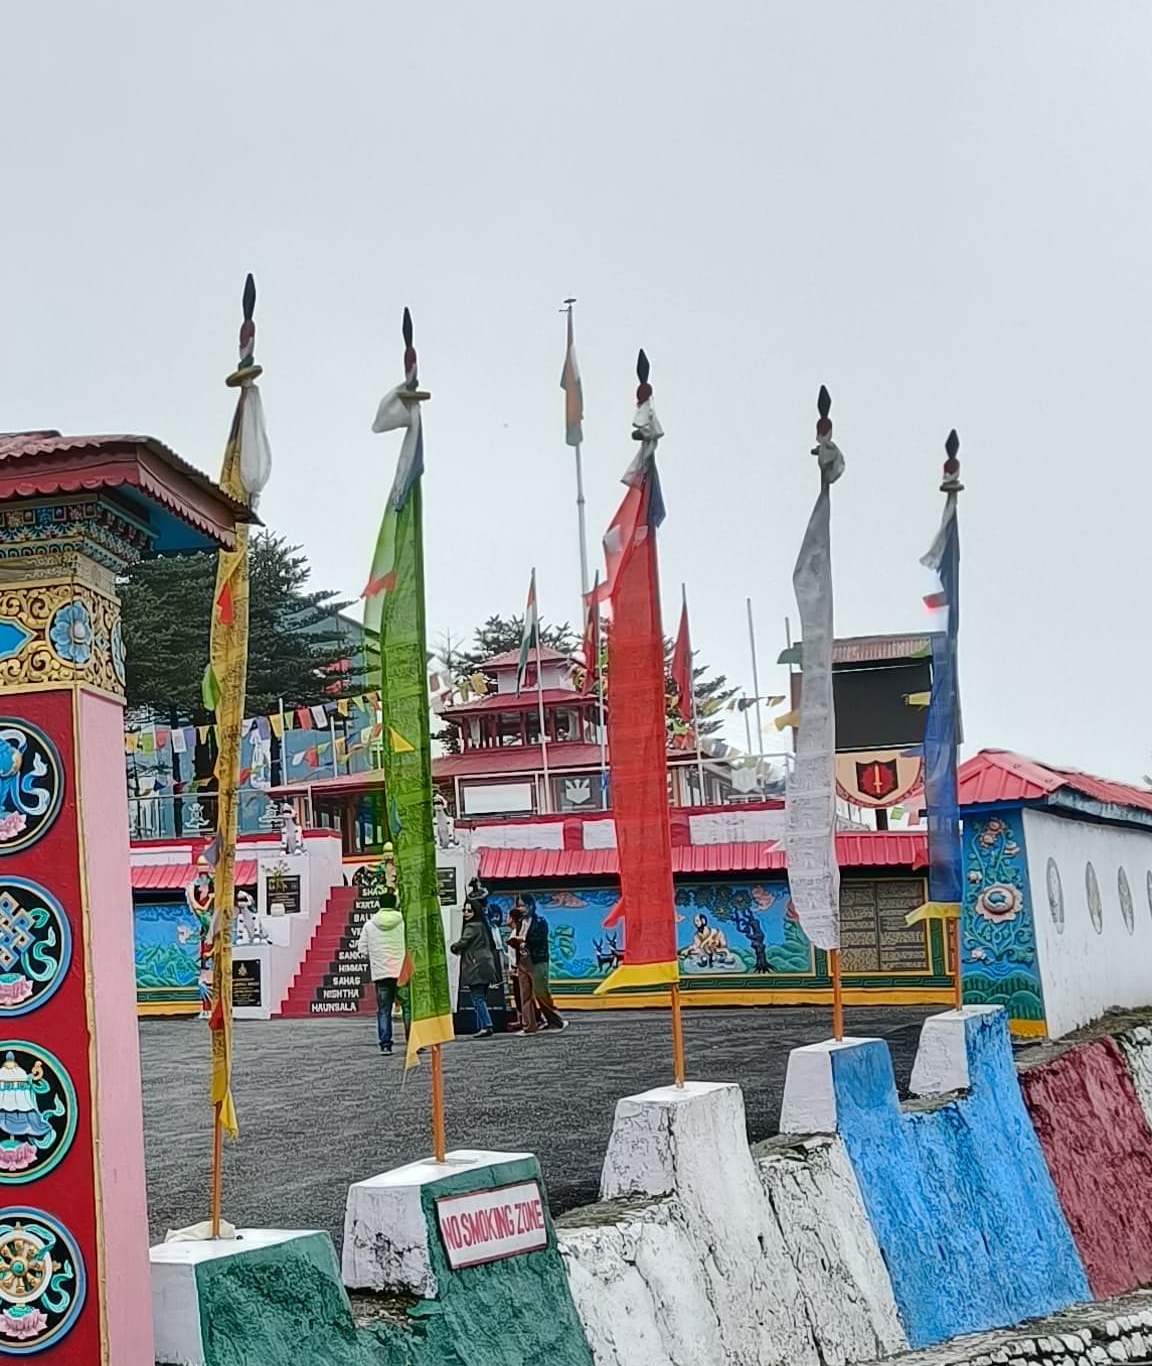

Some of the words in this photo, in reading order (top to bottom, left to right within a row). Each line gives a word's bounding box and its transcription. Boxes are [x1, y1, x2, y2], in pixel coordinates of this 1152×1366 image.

[332, 976, 361, 986] SAHAS
[442, 1215, 463, 1250] NO
[460, 1204, 515, 1247] SMOKING
[514, 1199, 545, 1235] ZONE
